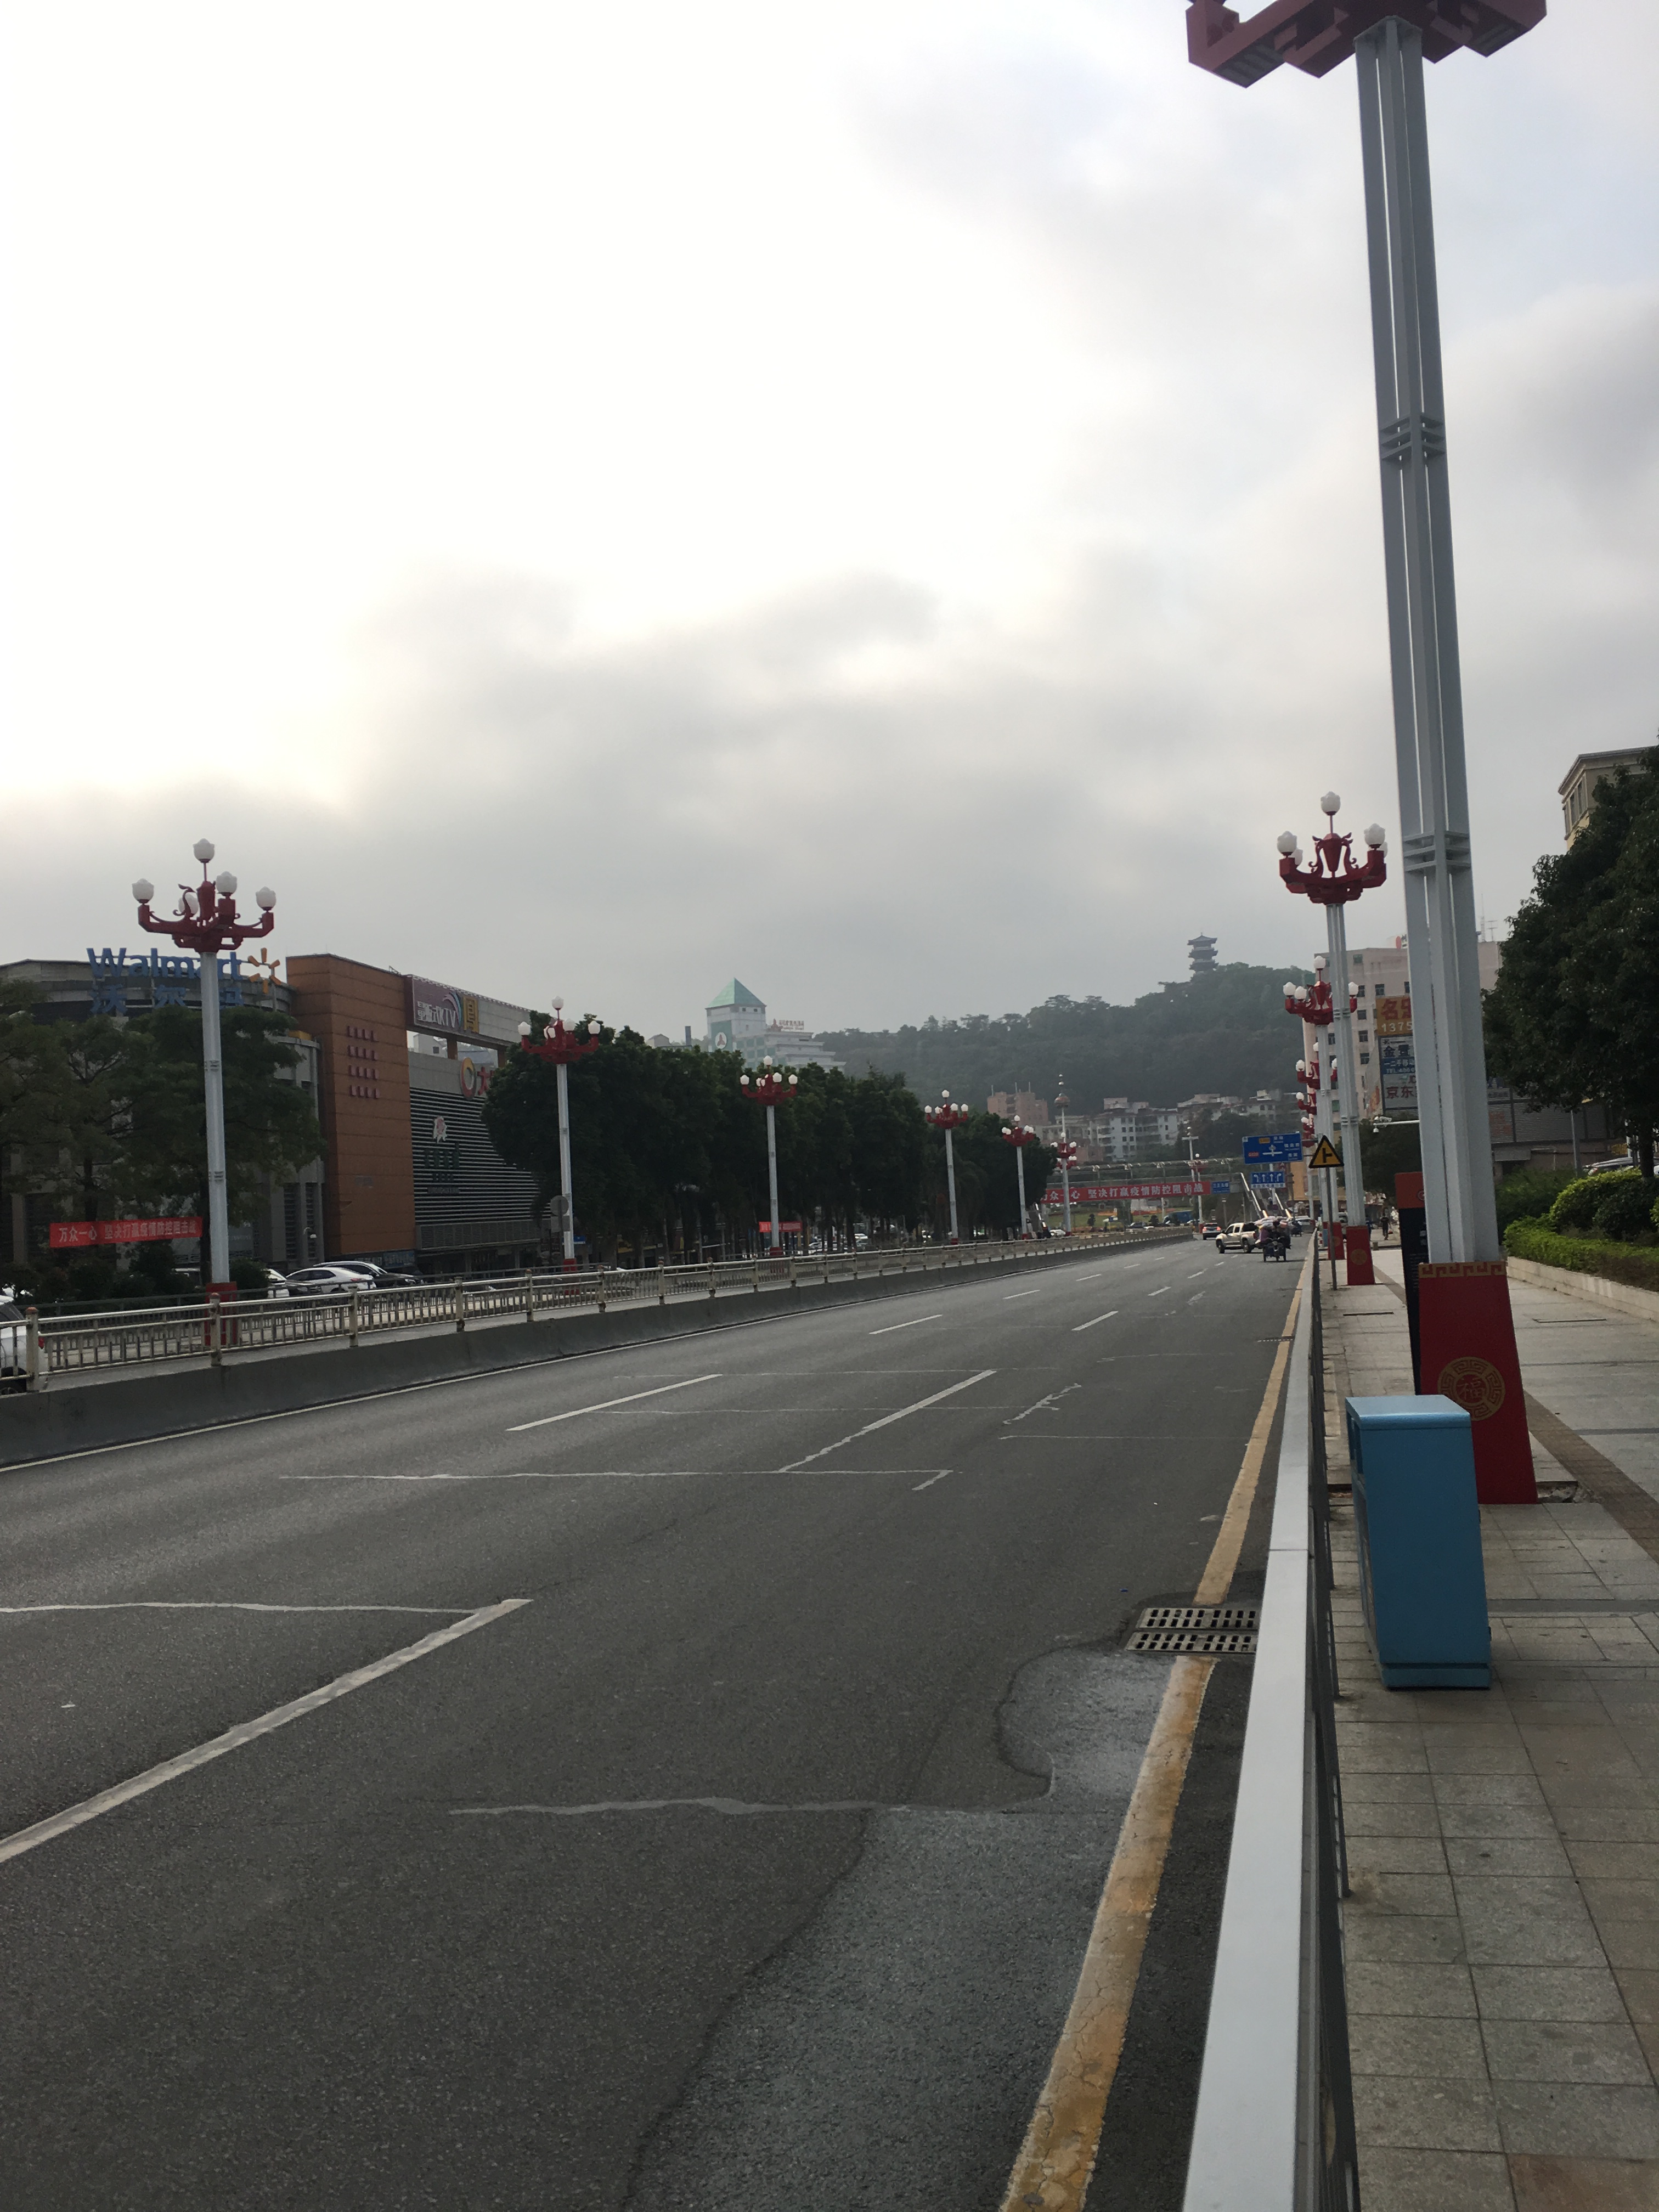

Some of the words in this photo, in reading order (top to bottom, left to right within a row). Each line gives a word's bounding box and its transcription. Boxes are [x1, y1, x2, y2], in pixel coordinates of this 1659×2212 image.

[86, 947, 243, 980] Walmrt
[1386, 1085, 1417, 1099] 京东
[59, 1225, 97, 1243] 万众一心
[1457, 1377, 1485, 1400] 福
